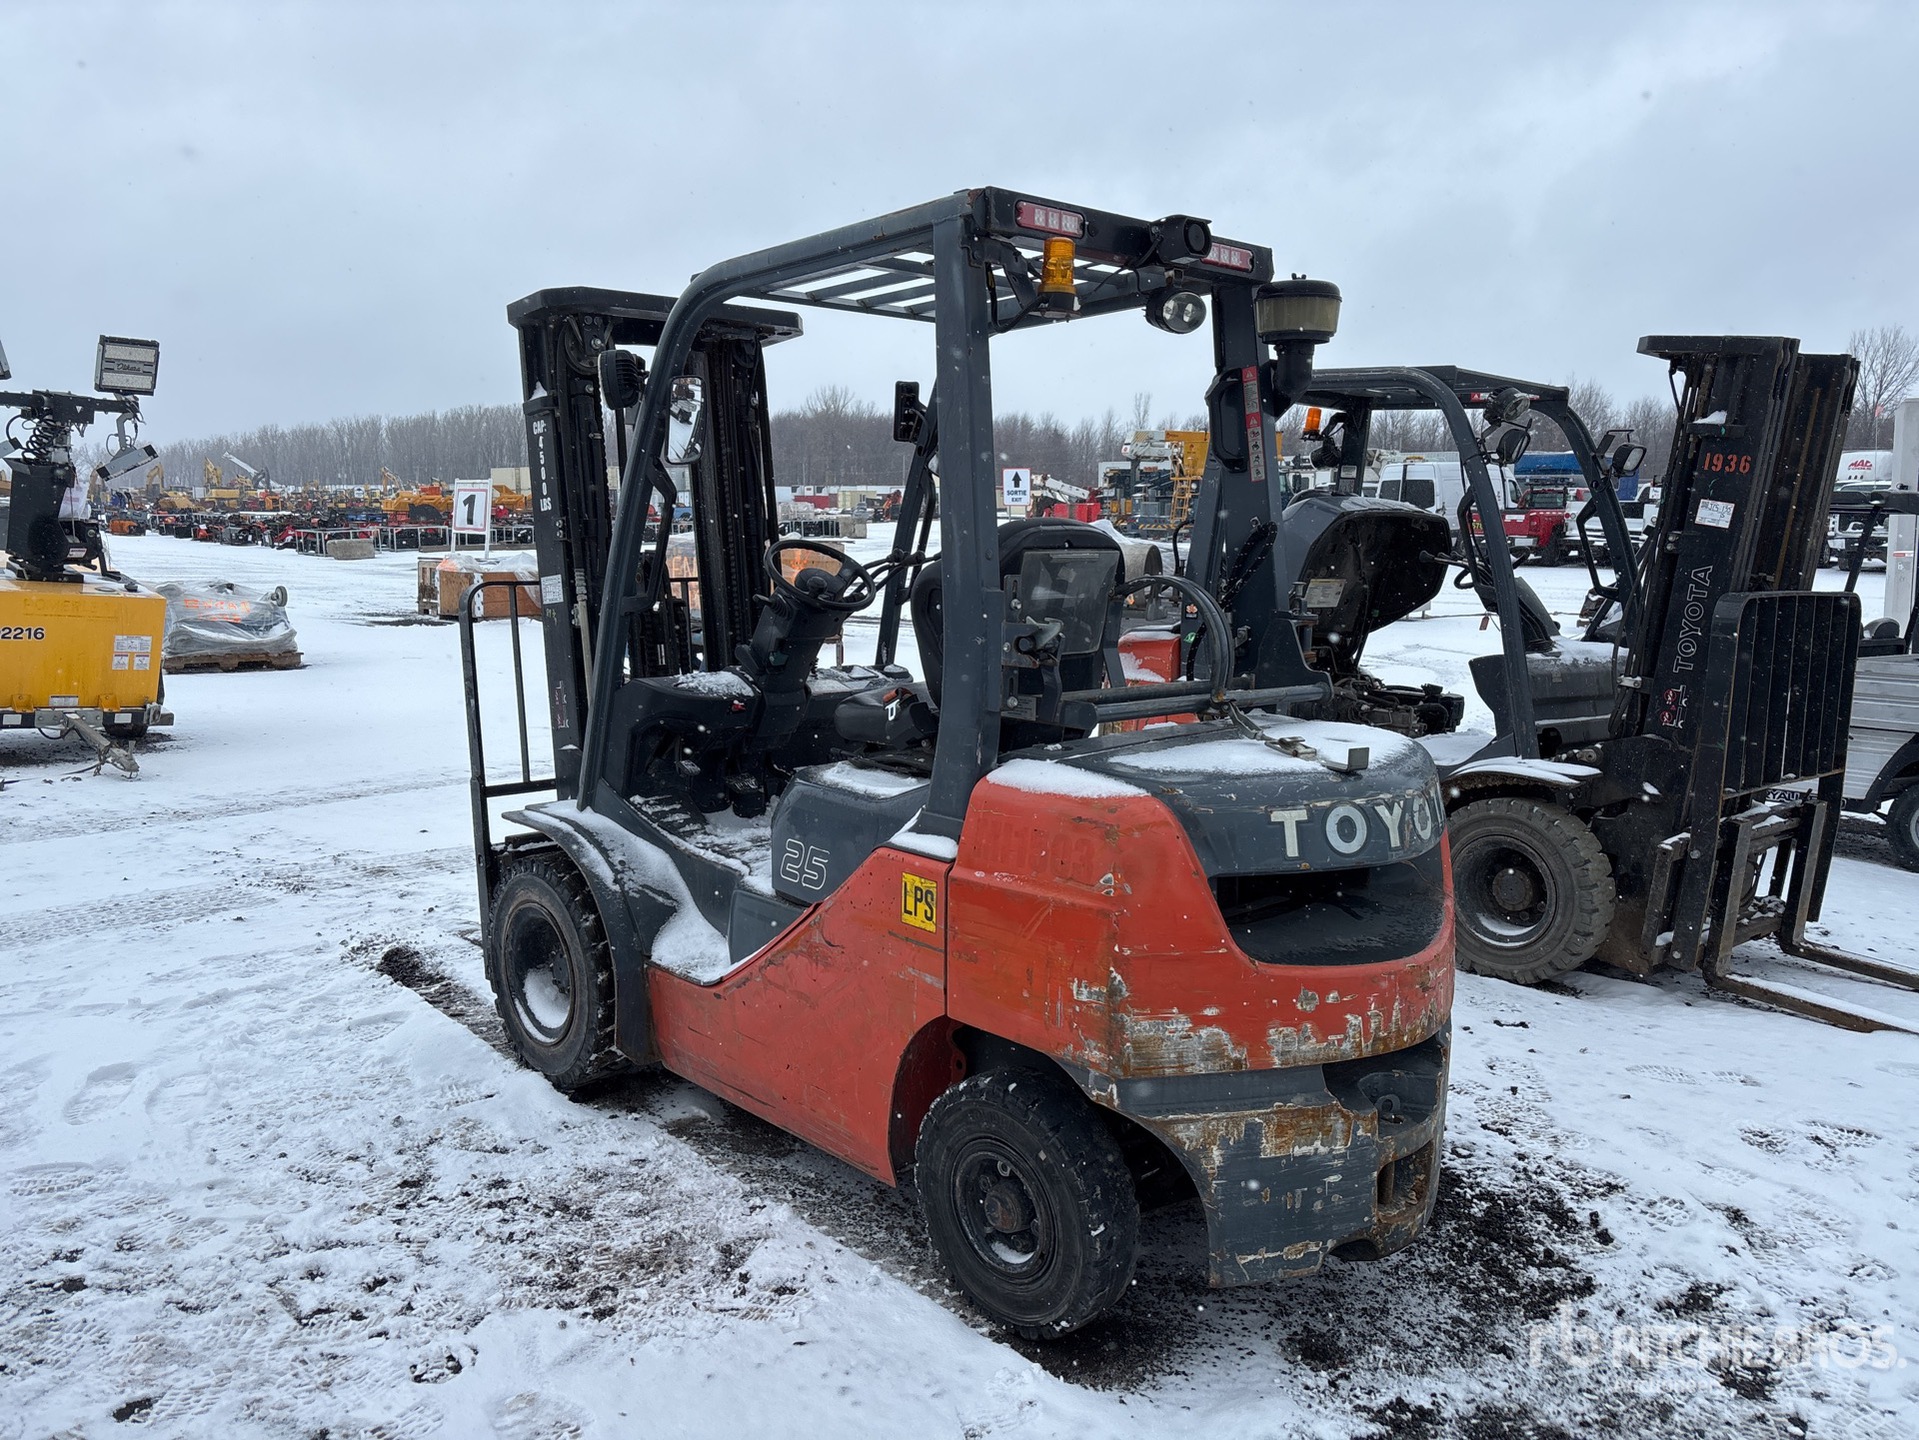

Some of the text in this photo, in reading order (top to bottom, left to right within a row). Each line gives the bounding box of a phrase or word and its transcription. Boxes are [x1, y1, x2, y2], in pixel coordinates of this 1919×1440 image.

[538, 435, 548, 496] 4500
[1703, 452, 1752, 474] 1936
[462, 494, 476, 526] 1
[540, 497, 552, 511] LBS
[0, 626, 46, 640] 2216
[1672, 565, 1714, 674] TOYOTA
[780, 838, 830, 890] 25
[903, 880, 935, 922] LPS
